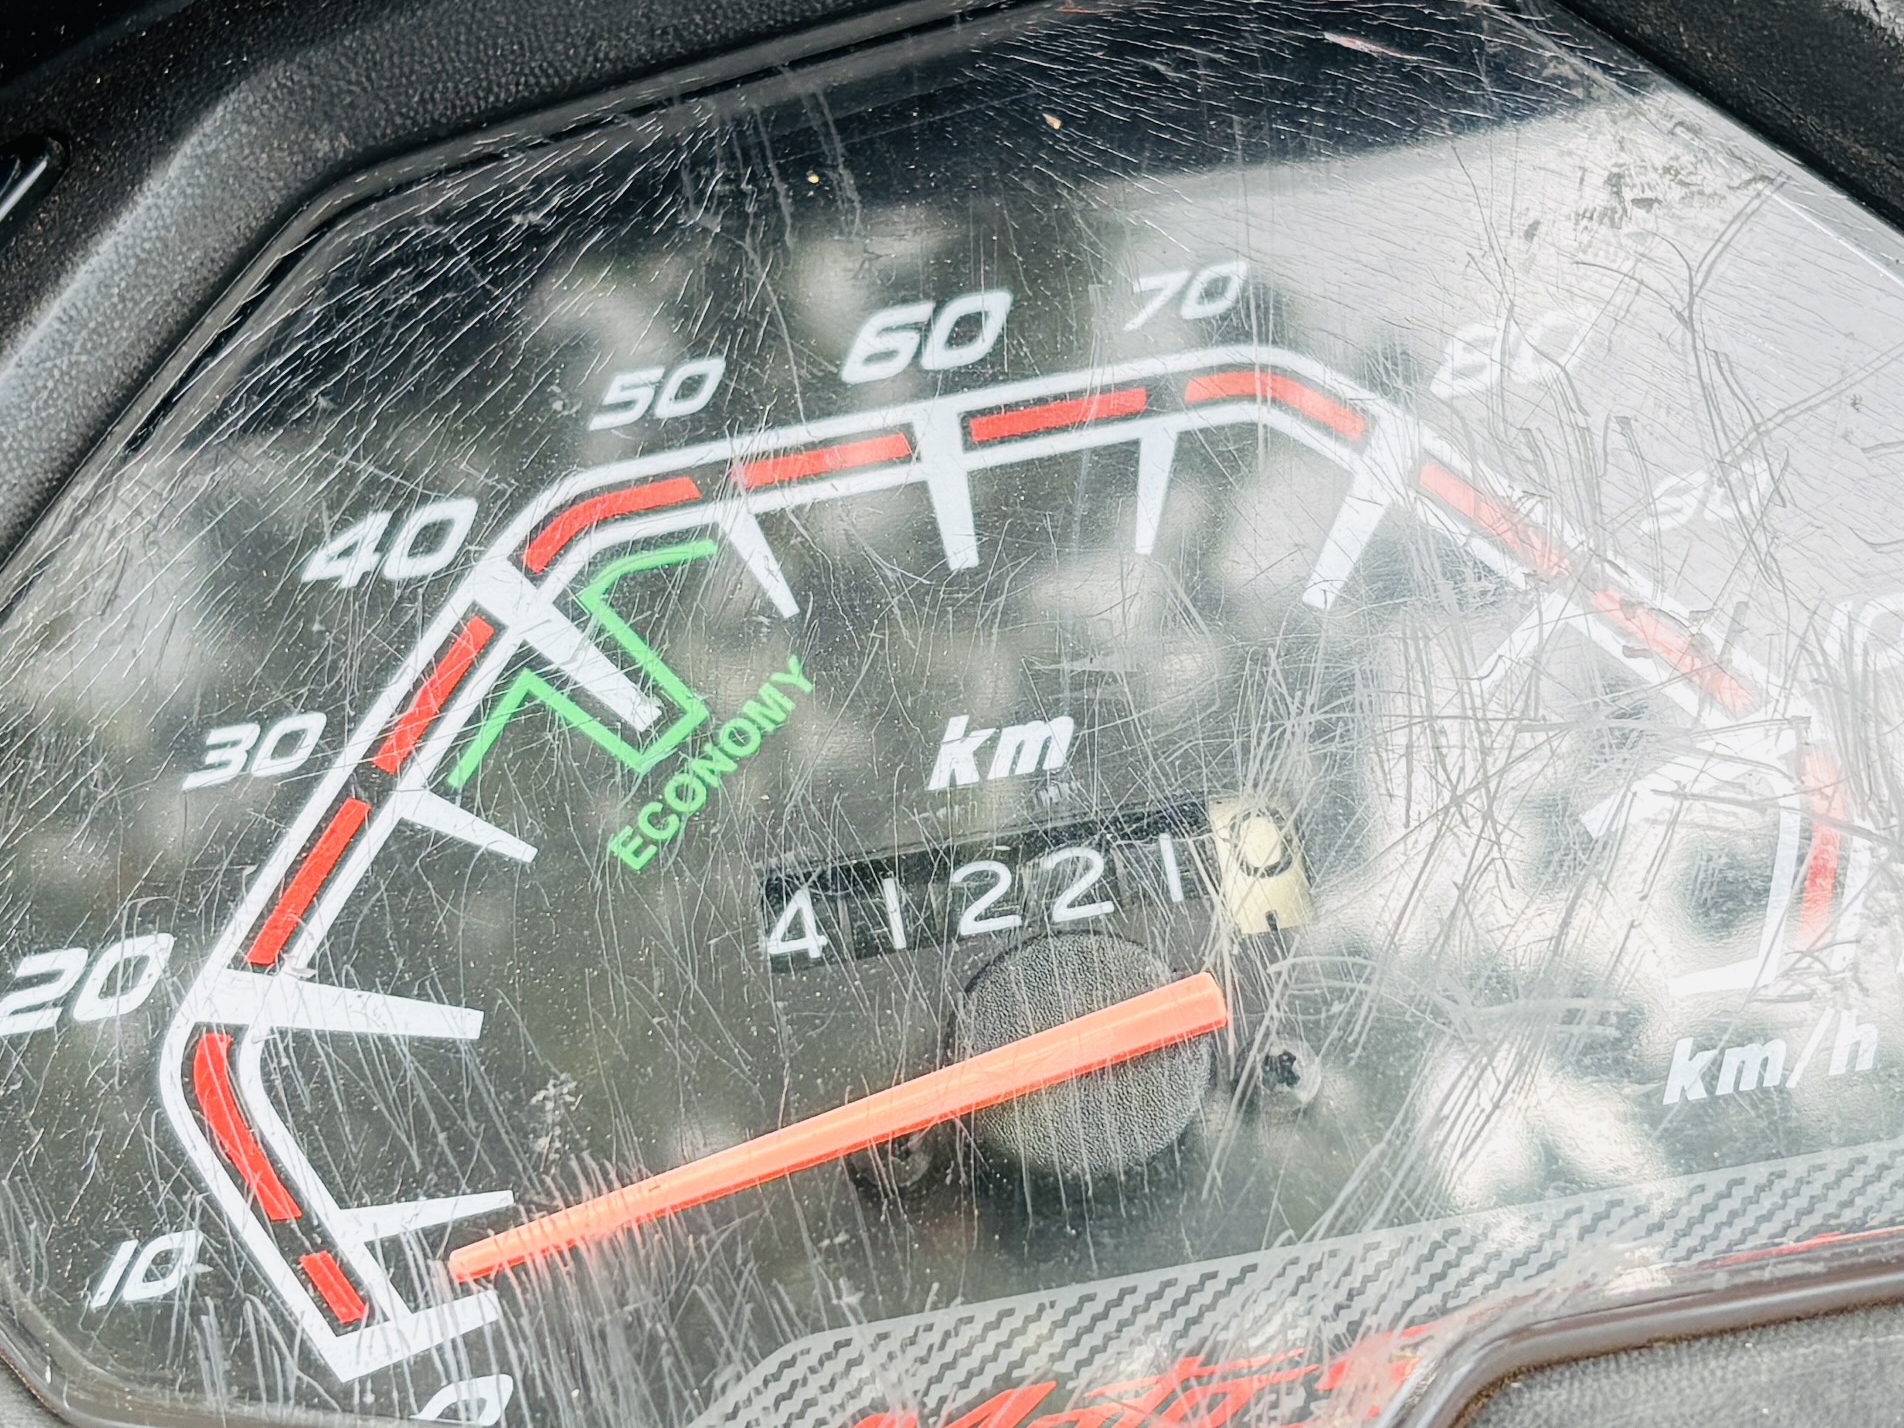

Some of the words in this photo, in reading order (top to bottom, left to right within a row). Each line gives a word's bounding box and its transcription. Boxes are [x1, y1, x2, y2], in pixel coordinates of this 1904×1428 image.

[841, 291, 1012, 383] 60
[1124, 261, 1250, 330] 70
[588, 357, 725, 430] 50
[1429, 306, 1598, 399] 80
[305, 498, 477, 587] 40
[183, 711, 325, 789] 30
[609, 655, 814, 870] ECONOMY
[927, 714, 1075, 791] km
[1662, 1007, 1879, 1106] km/h
[91, 1230, 204, 1309] 10
